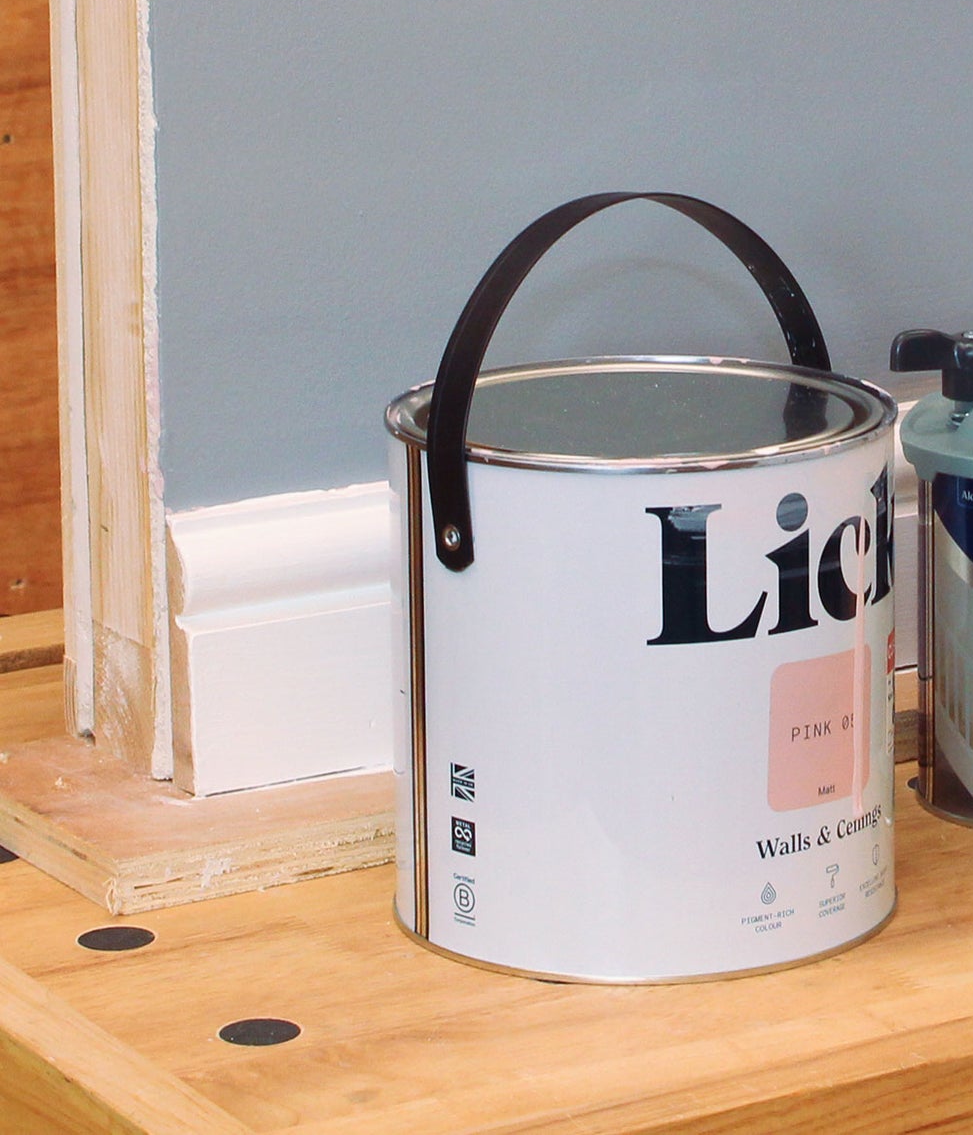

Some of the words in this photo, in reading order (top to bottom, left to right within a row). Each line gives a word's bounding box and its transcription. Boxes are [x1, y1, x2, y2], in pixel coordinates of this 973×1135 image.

[791, 721, 832, 742] PINK
[818, 785, 835, 796] Matt
[756, 833, 811, 859] Walls
[817, 826, 831, 846] &
[819, 893, 846, 907] SUPERIOR
[741, 909, 795, 924] PIGMENT-RICH
[818, 904, 845, 918] COVERAGE
[755, 922, 782, 933] COLOUR
